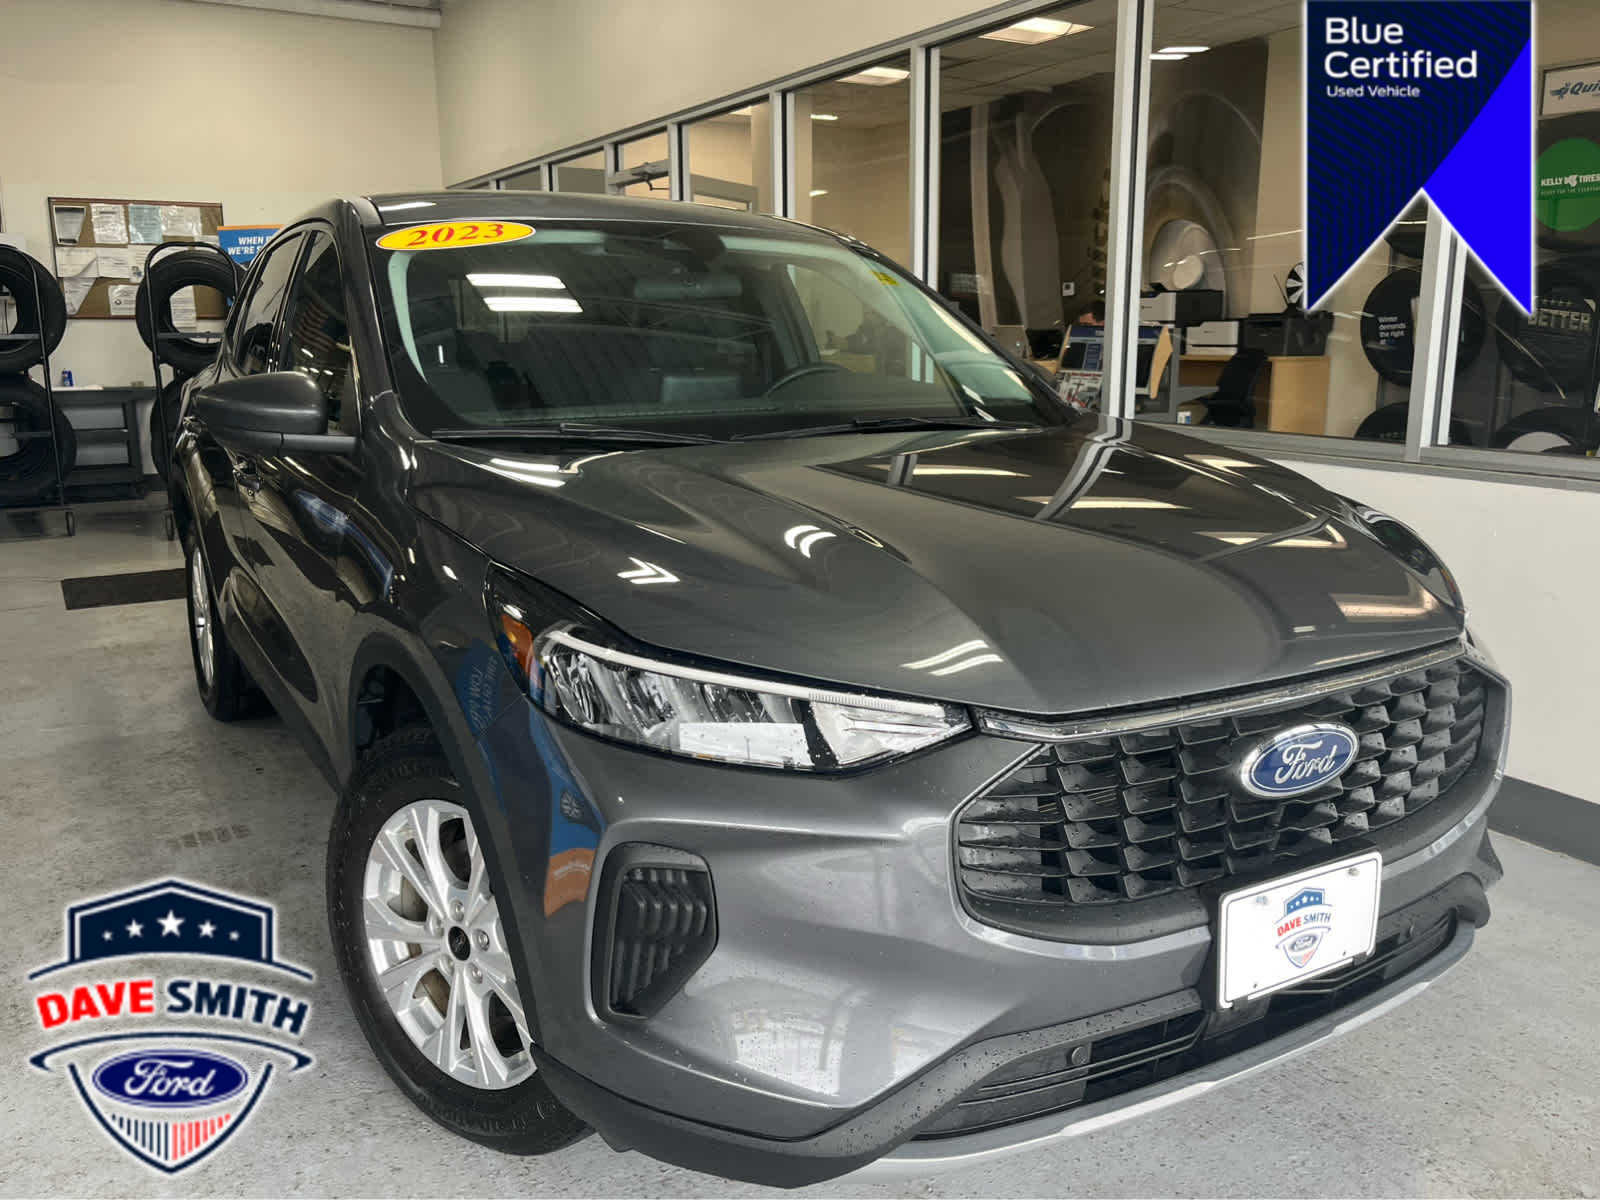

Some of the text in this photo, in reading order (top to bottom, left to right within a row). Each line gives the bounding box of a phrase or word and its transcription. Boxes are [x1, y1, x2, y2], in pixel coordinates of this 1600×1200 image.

[1541, 177, 1563, 186] KELLY
[238, 236, 264, 245] WHEN
[407, 223, 504, 247] 2023
[227, 246, 255, 255] WE'RE
[1274, 740, 1337, 784] Ford
[1277, 912, 1332, 936] DAVE SMITH
